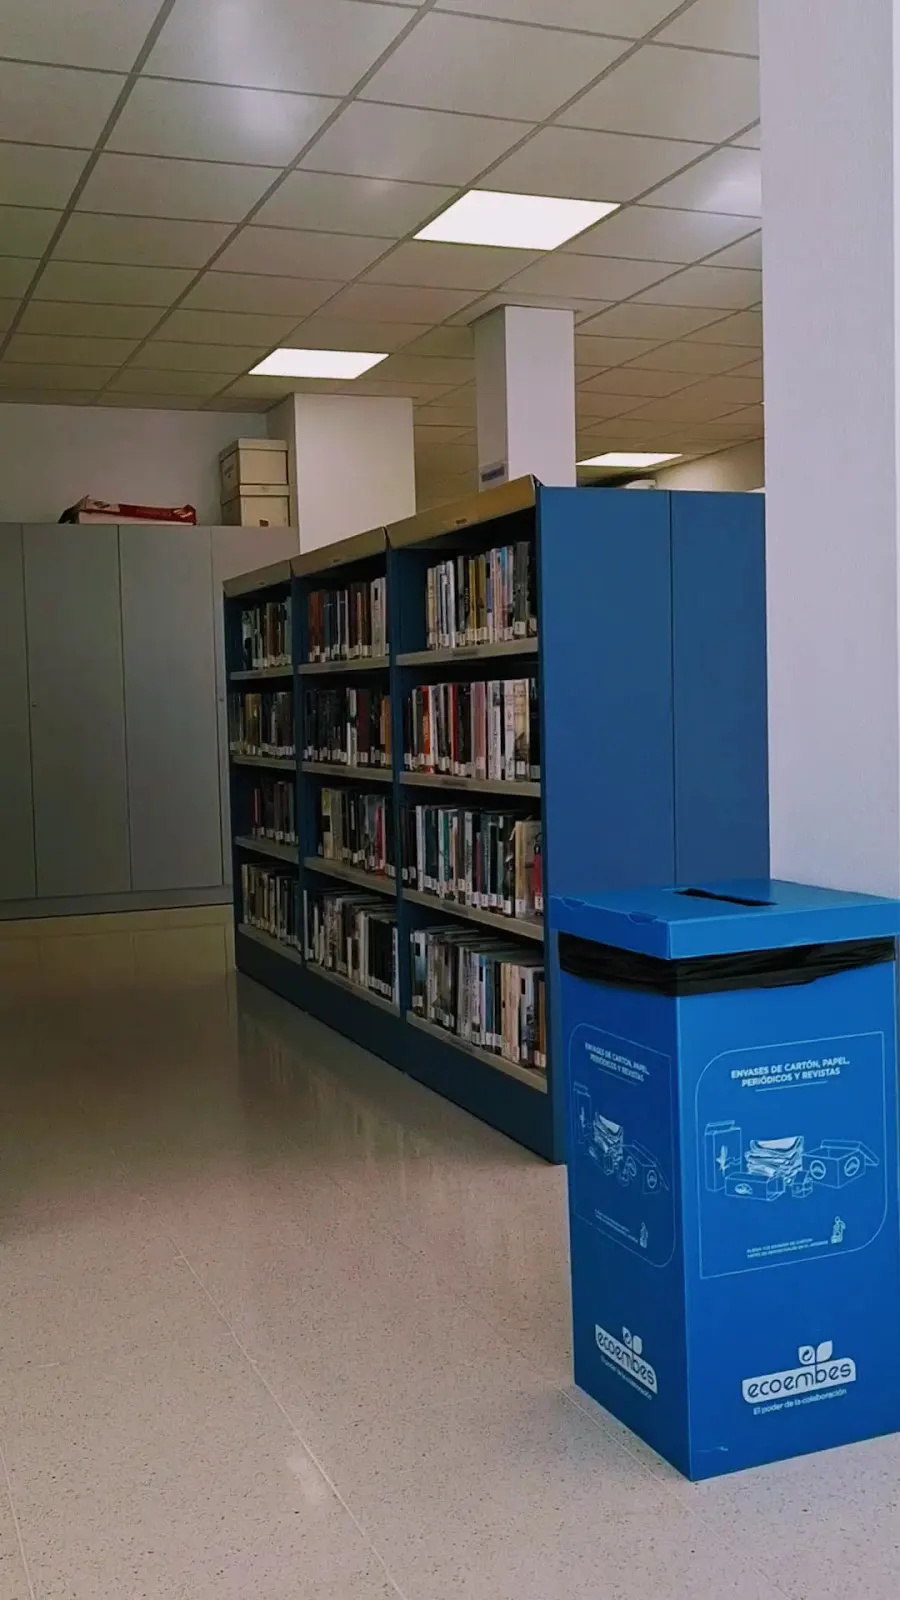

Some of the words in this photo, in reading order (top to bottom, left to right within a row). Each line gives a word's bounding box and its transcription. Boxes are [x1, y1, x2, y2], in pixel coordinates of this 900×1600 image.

[731, 1066, 769, 1079] ENVASES
[771, 1064, 782, 1074] DE
[742, 1073, 793, 1087] PERIÓDICOS
[802, 1067, 841, 1080] REVISTAS
[598, 1332, 655, 1385] ecoembes
[747, 1358, 852, 1398] ecoembes
[753, 1407, 760, 1416] El
[761, 1403, 783, 1414] poder
[784, 1400, 794, 1409] de
[794, 1398, 801, 1406] la
[801, 1388, 848, 1405] colaboración
